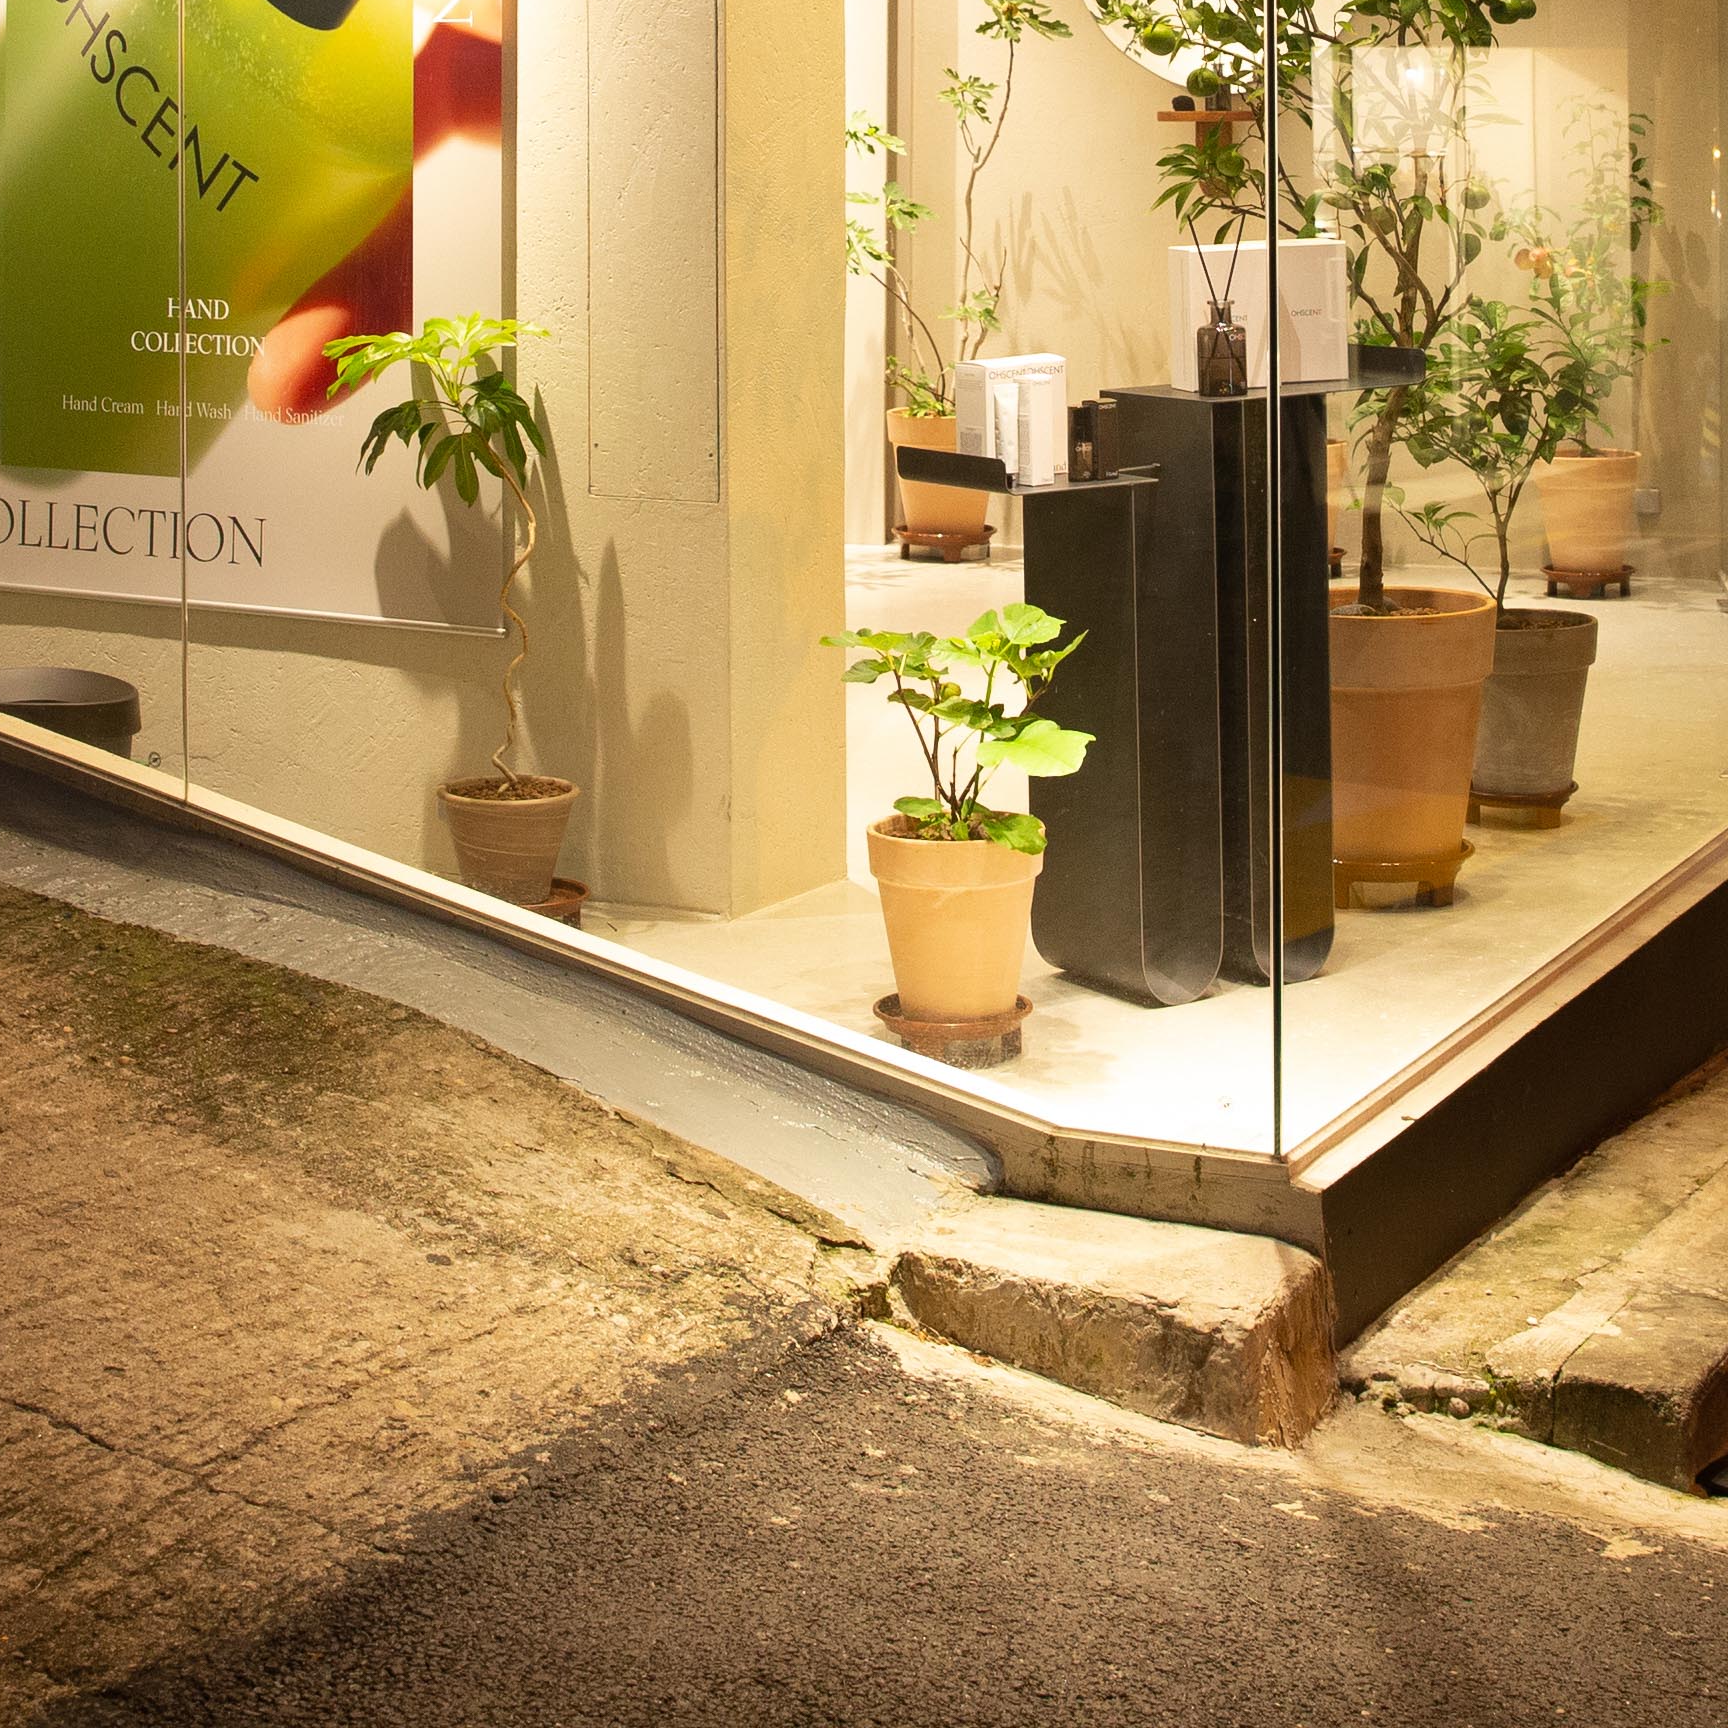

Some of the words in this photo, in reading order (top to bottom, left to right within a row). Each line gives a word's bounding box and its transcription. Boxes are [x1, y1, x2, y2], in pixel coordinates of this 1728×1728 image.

[167, 296, 230, 321] HAND
[1231, 314, 1248, 323] CENT
[1290, 308, 1323, 317] OHSCENT
[130, 330, 267, 358] COLLECTION
[61, 394, 98, 413] Hand
[100, 396, 145, 416] Cream
[155, 399, 193, 419] Hand
[195, 402, 233, 421] Wash
[244, 404, 282, 424] Hand
[284, 407, 346, 429] Sanitizer
